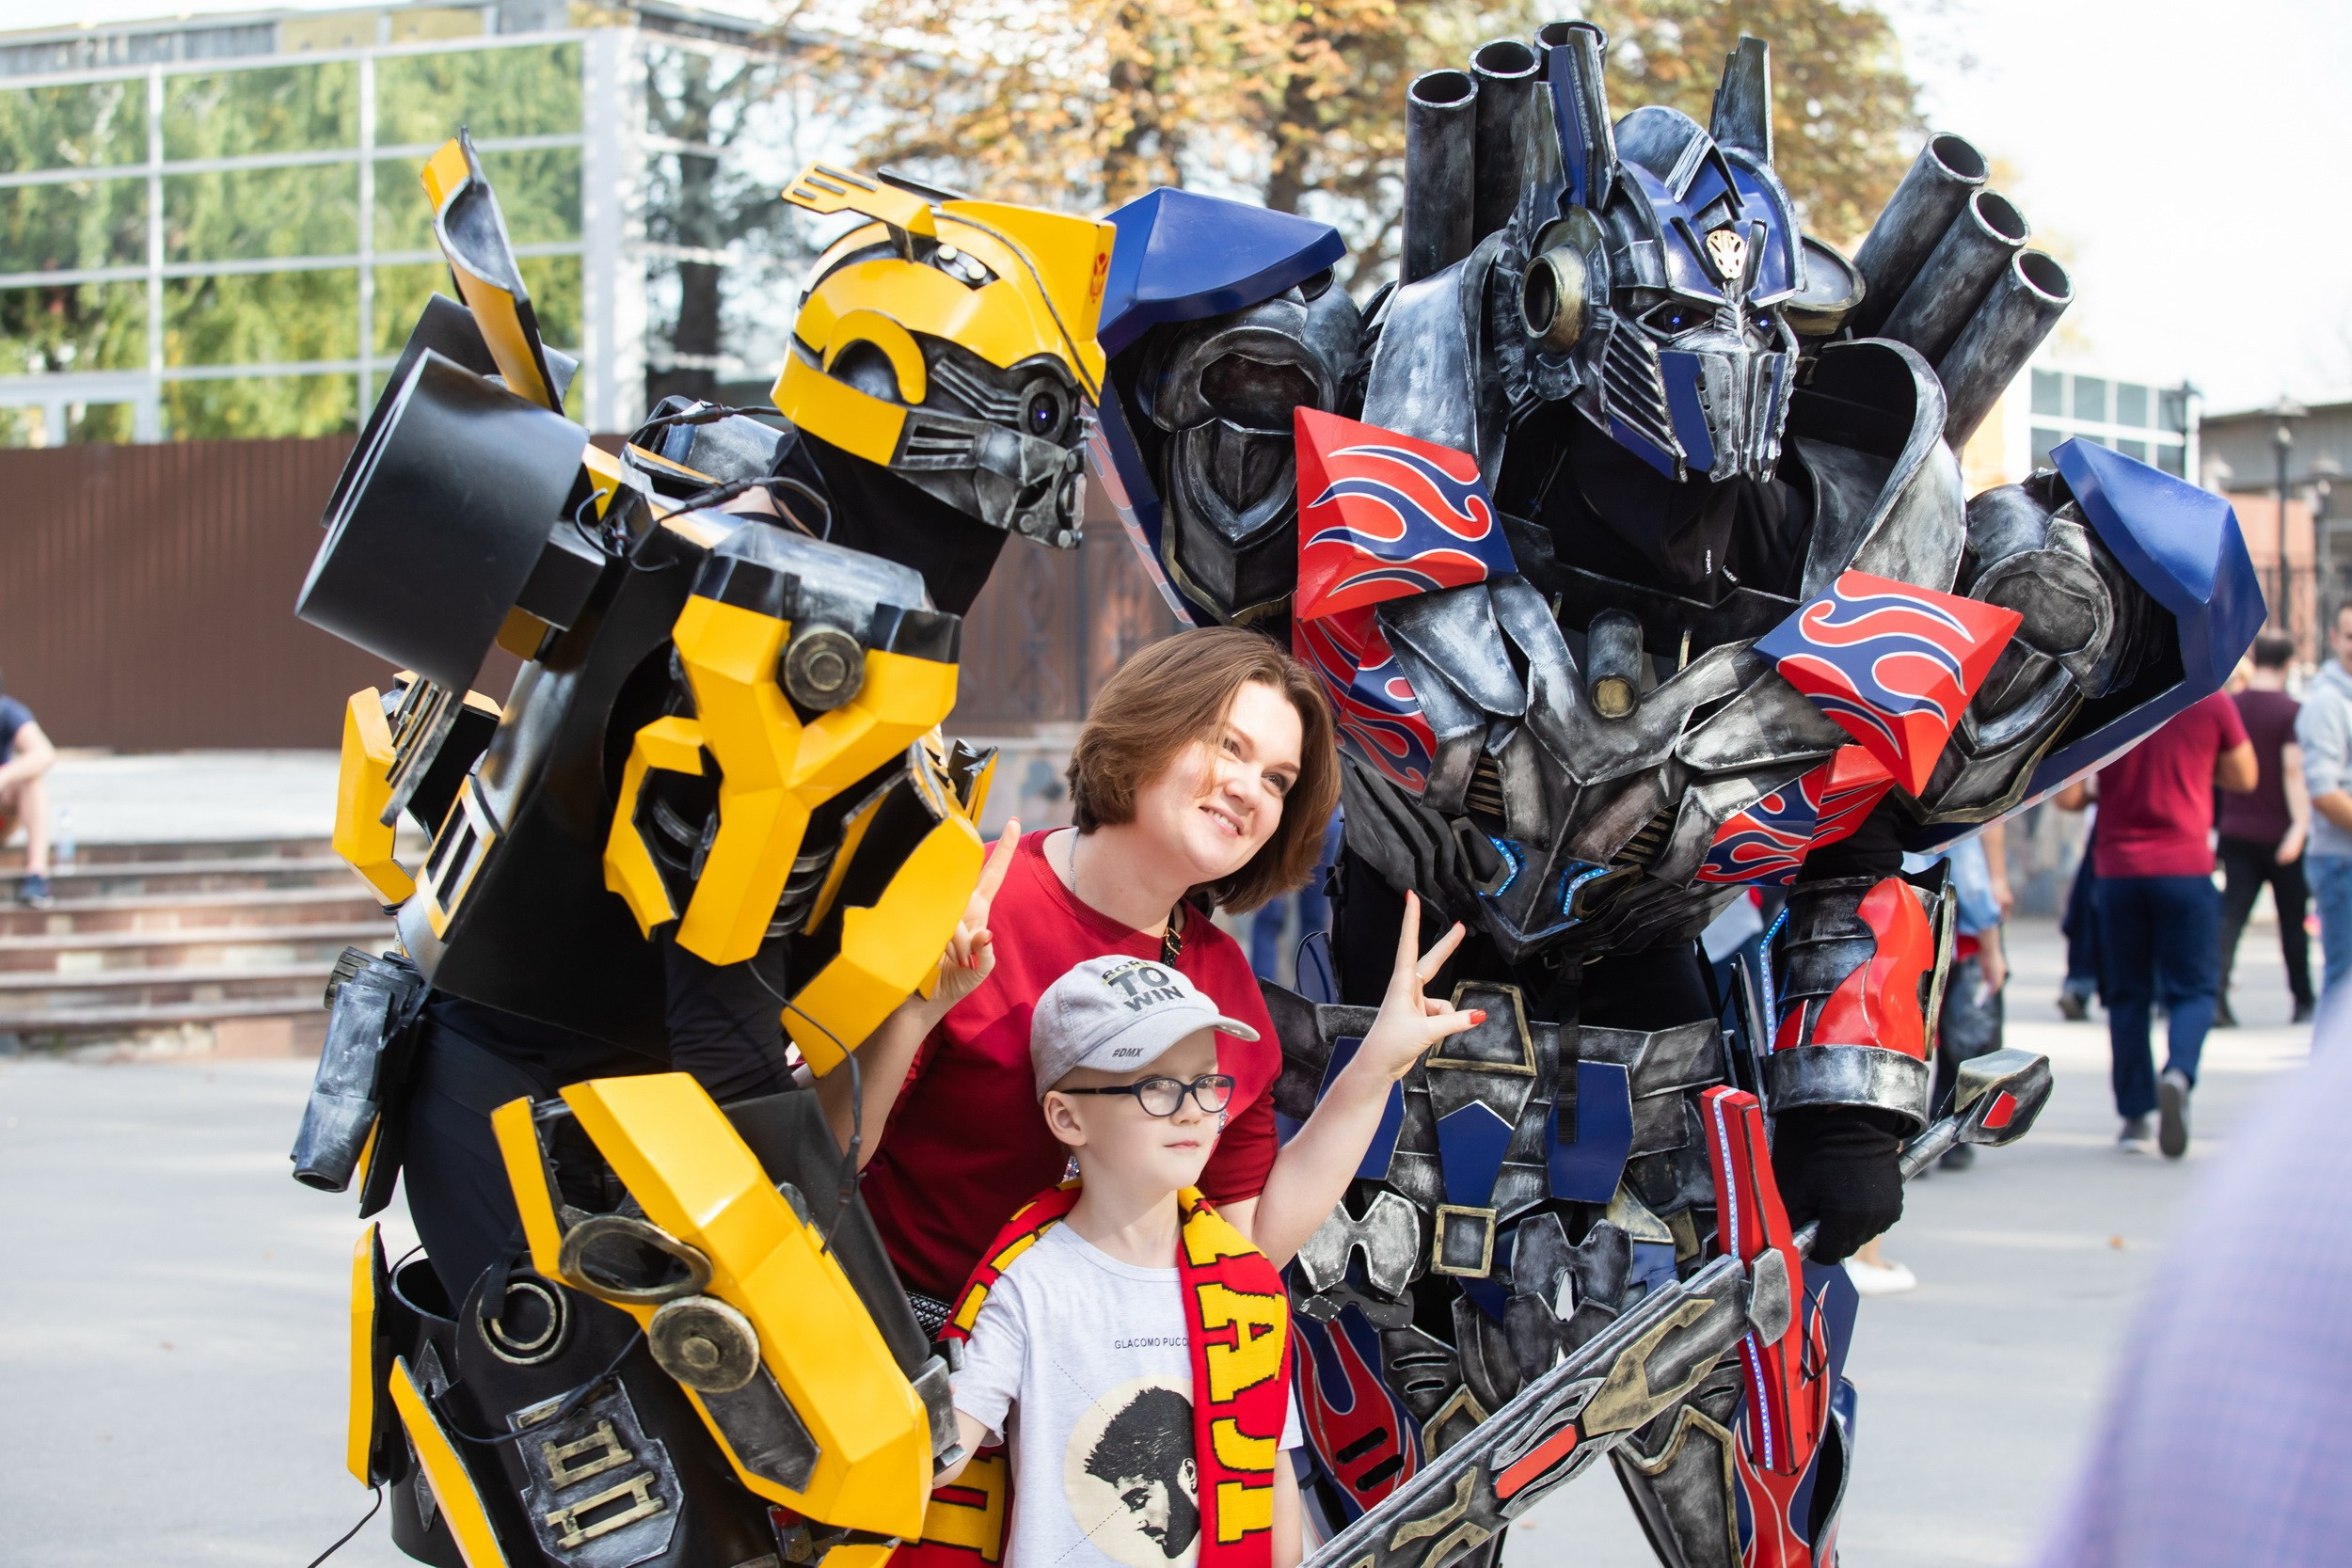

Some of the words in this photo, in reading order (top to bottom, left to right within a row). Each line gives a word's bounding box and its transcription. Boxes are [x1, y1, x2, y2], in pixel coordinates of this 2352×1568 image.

[1108, 967, 1169, 997] TO
[1123, 986, 1185, 1012] WIN
[1112, 1048, 1144, 1057] #DMX
[1114, 1338, 1160, 1350] GLACOMO
